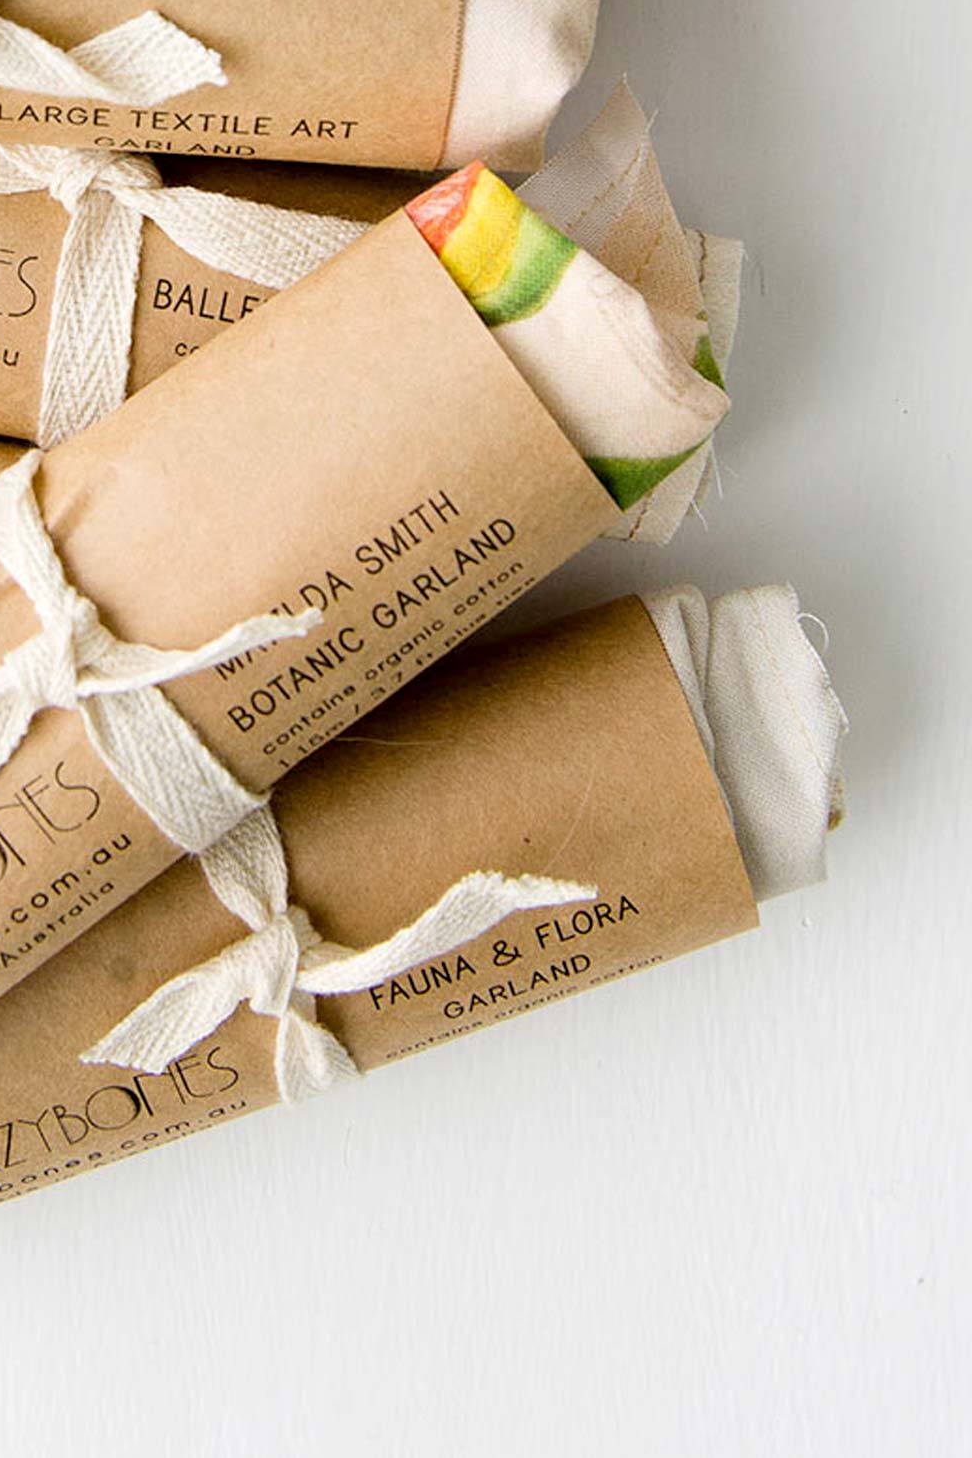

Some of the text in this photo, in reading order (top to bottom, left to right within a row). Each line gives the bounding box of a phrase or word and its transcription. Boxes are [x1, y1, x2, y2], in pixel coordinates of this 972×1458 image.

[93, 136, 257, 157] GARLAND
[130, 110, 272, 136] TEXTILE
[290, 119, 358, 139] ART
[153, 278, 268, 324] BALLE
[354, 490, 460, 576] SMITH
[227, 627, 365, 733] BOTANIC
[371, 518, 517, 630] GARLAND
[262, 683, 356, 756] contains
[364, 619, 445, 681] organic
[453, 561, 524, 616] cotton
[0, 880, 116, 968] Australia
[369, 895, 640, 1011] FAUNA & FLORA
[443, 953, 592, 1019] GARLAND
